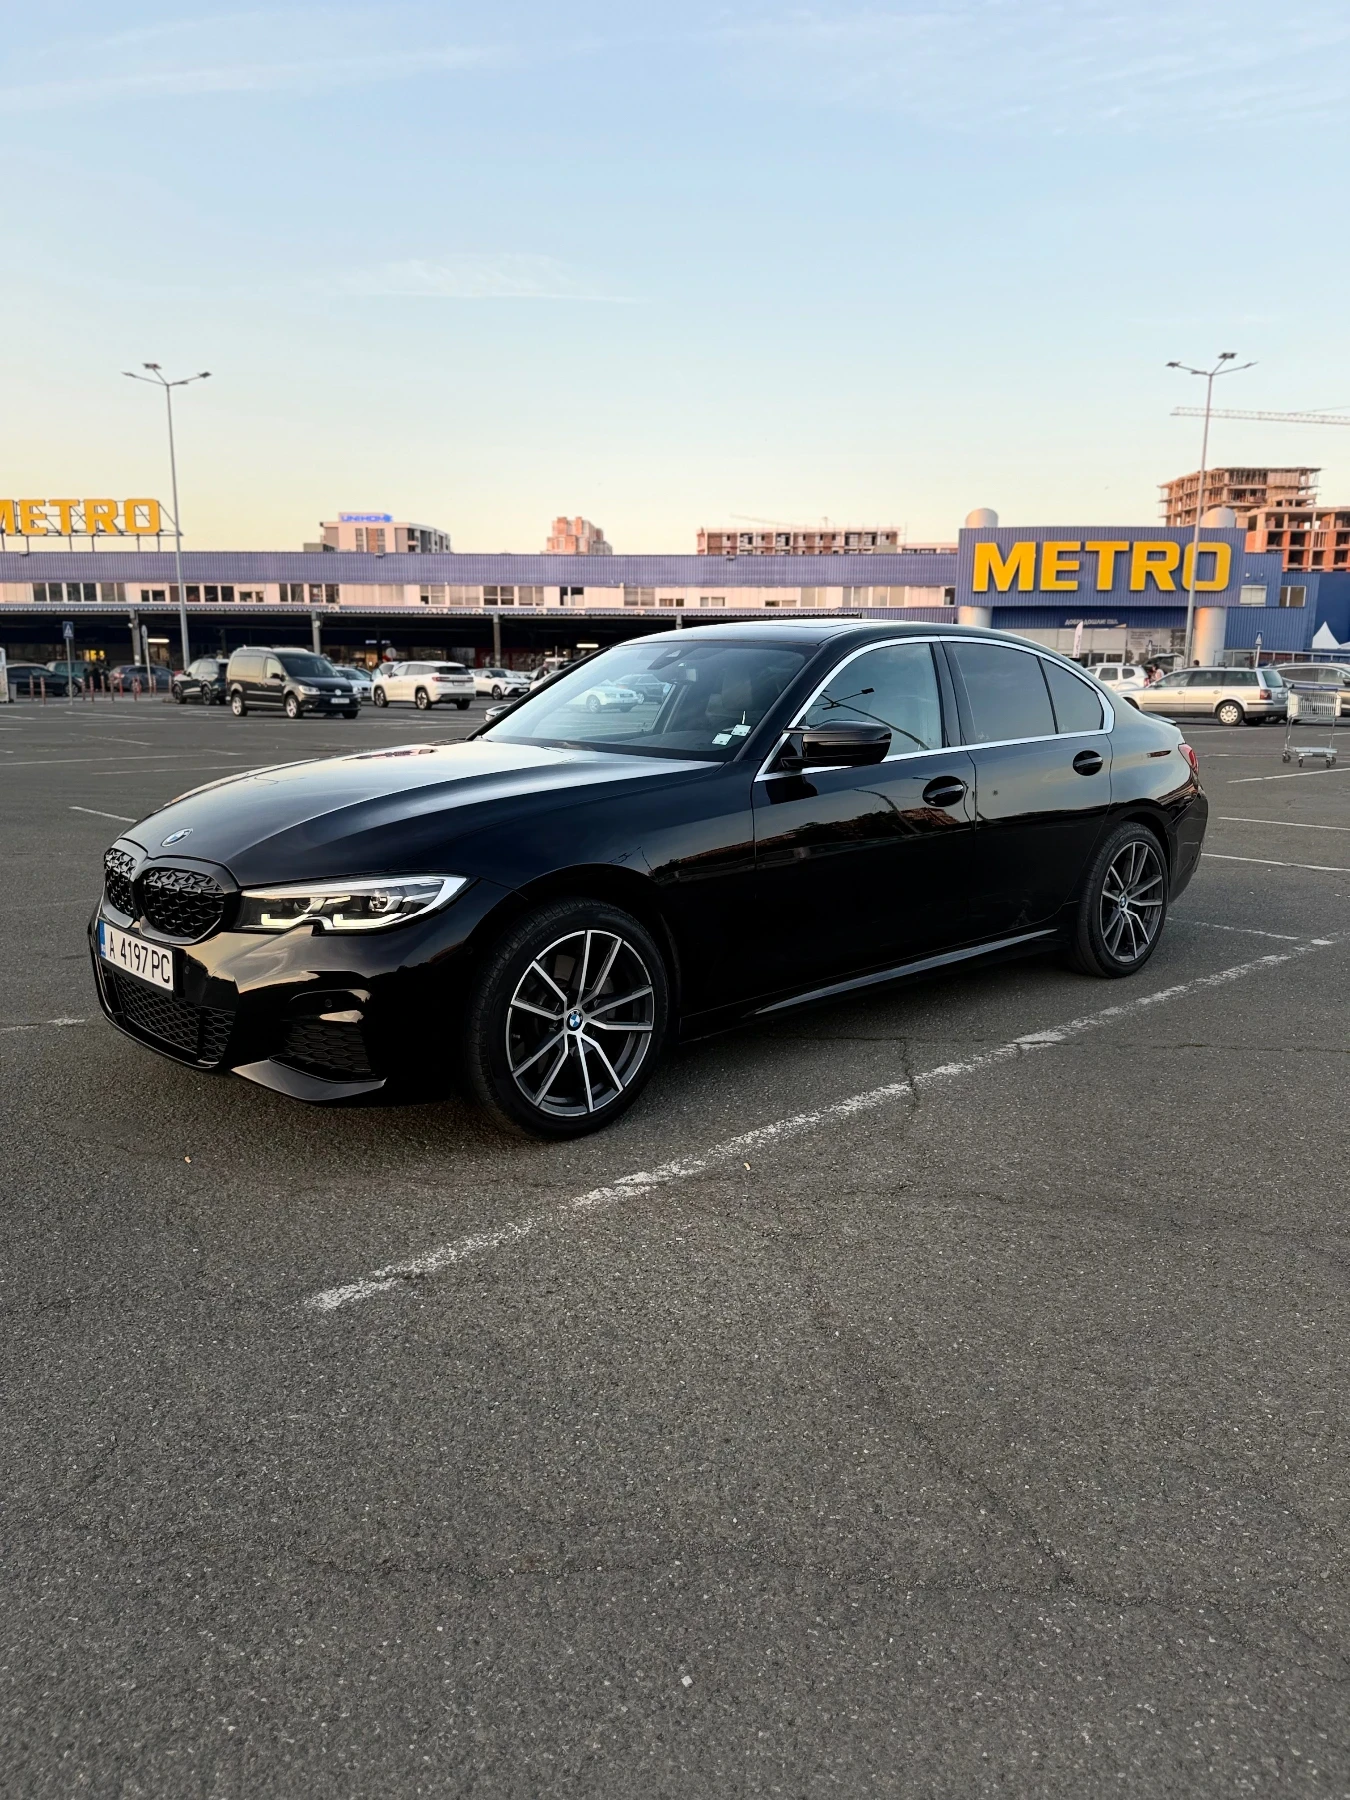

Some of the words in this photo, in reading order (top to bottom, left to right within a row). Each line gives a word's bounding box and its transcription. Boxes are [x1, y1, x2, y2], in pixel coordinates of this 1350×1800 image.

[972, 541, 1231, 592] METRO
[109, 931, 116, 960] A
[120, 937, 149, 974] 4197
[151, 949, 170, 984] PC
